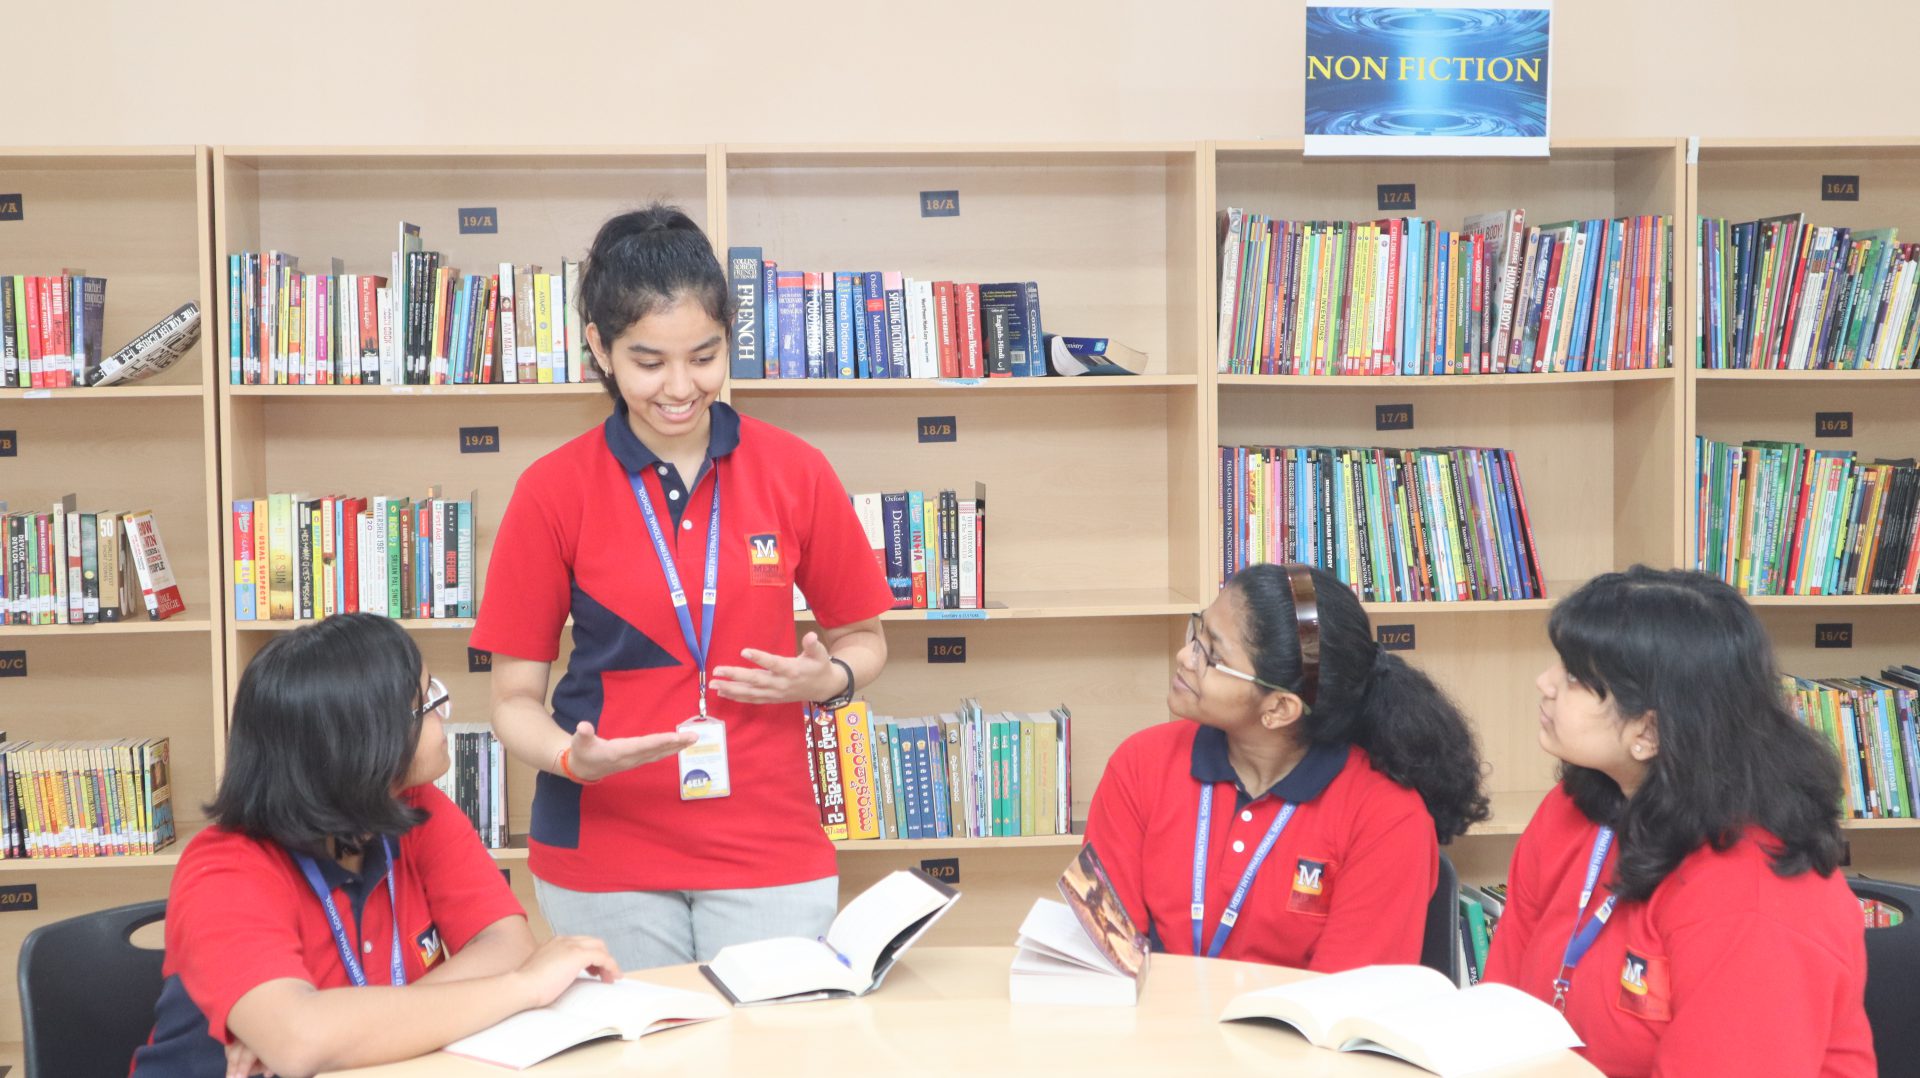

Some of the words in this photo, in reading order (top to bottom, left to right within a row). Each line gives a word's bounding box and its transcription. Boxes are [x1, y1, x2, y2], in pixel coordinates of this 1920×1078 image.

[1307, 55, 1389, 80] NON
[1398, 56, 1541, 82] FICTION
[1383, 192, 1410, 203] 17/A
[1827, 184, 1855, 194] 16/A
[927, 200, 954, 210] 18/A
[463, 216, 493, 227] 19/A
[766, 270, 774, 293] Oxford
[1504, 265, 1517, 301] HUMAN
[824, 292, 833, 312] BETTER
[840, 294, 848, 320] French
[855, 295, 863, 329] ENGLISH
[889, 292, 901, 324] SPELLING
[1544, 287, 1555, 320] SCIENCE
[737, 284, 755, 360] FRENCH
[1318, 298, 1327, 341] INVENTIONS
[1500, 303, 1512, 330] BODY!
[825, 313, 835, 353] WORDPOWER
[840, 323, 849, 363] Dictionary
[872, 315, 882, 362] Mathematics
[891, 325, 903, 366] DICTIONARY
[995, 314, 1004, 359] English-Hindi
[1030, 309, 1038, 354] Compact
[858, 330, 866, 362] IDIOMS
[923, 424, 951, 435] 18/B
[1381, 412, 1408, 423] 17/B
[1820, 420, 1849, 431] 16/B
[465, 435, 494, 446] 19/B
[95, 519, 113, 537] 50
[376, 502, 384, 539] WATERSHED
[708, 510, 719, 564] INTERNATIONAL
[754, 540, 775, 558] M
[892, 510, 903, 567] Dictionary
[276, 565, 286, 584] SUN
[446, 550, 456, 584] REFUGEE
[1382, 632, 1410, 643] 17/C
[1820, 631, 1848, 641] 16/C
[933, 645, 962, 656] 18/C
[1883, 730, 1892, 758] WORLD
[1886, 760, 1897, 792] HISTORY
[1241, 832, 1275, 888] INTERNATIONAL
[1298, 864, 1322, 889] M
[422, 930, 441, 959] M
[1624, 958, 1644, 988] M
